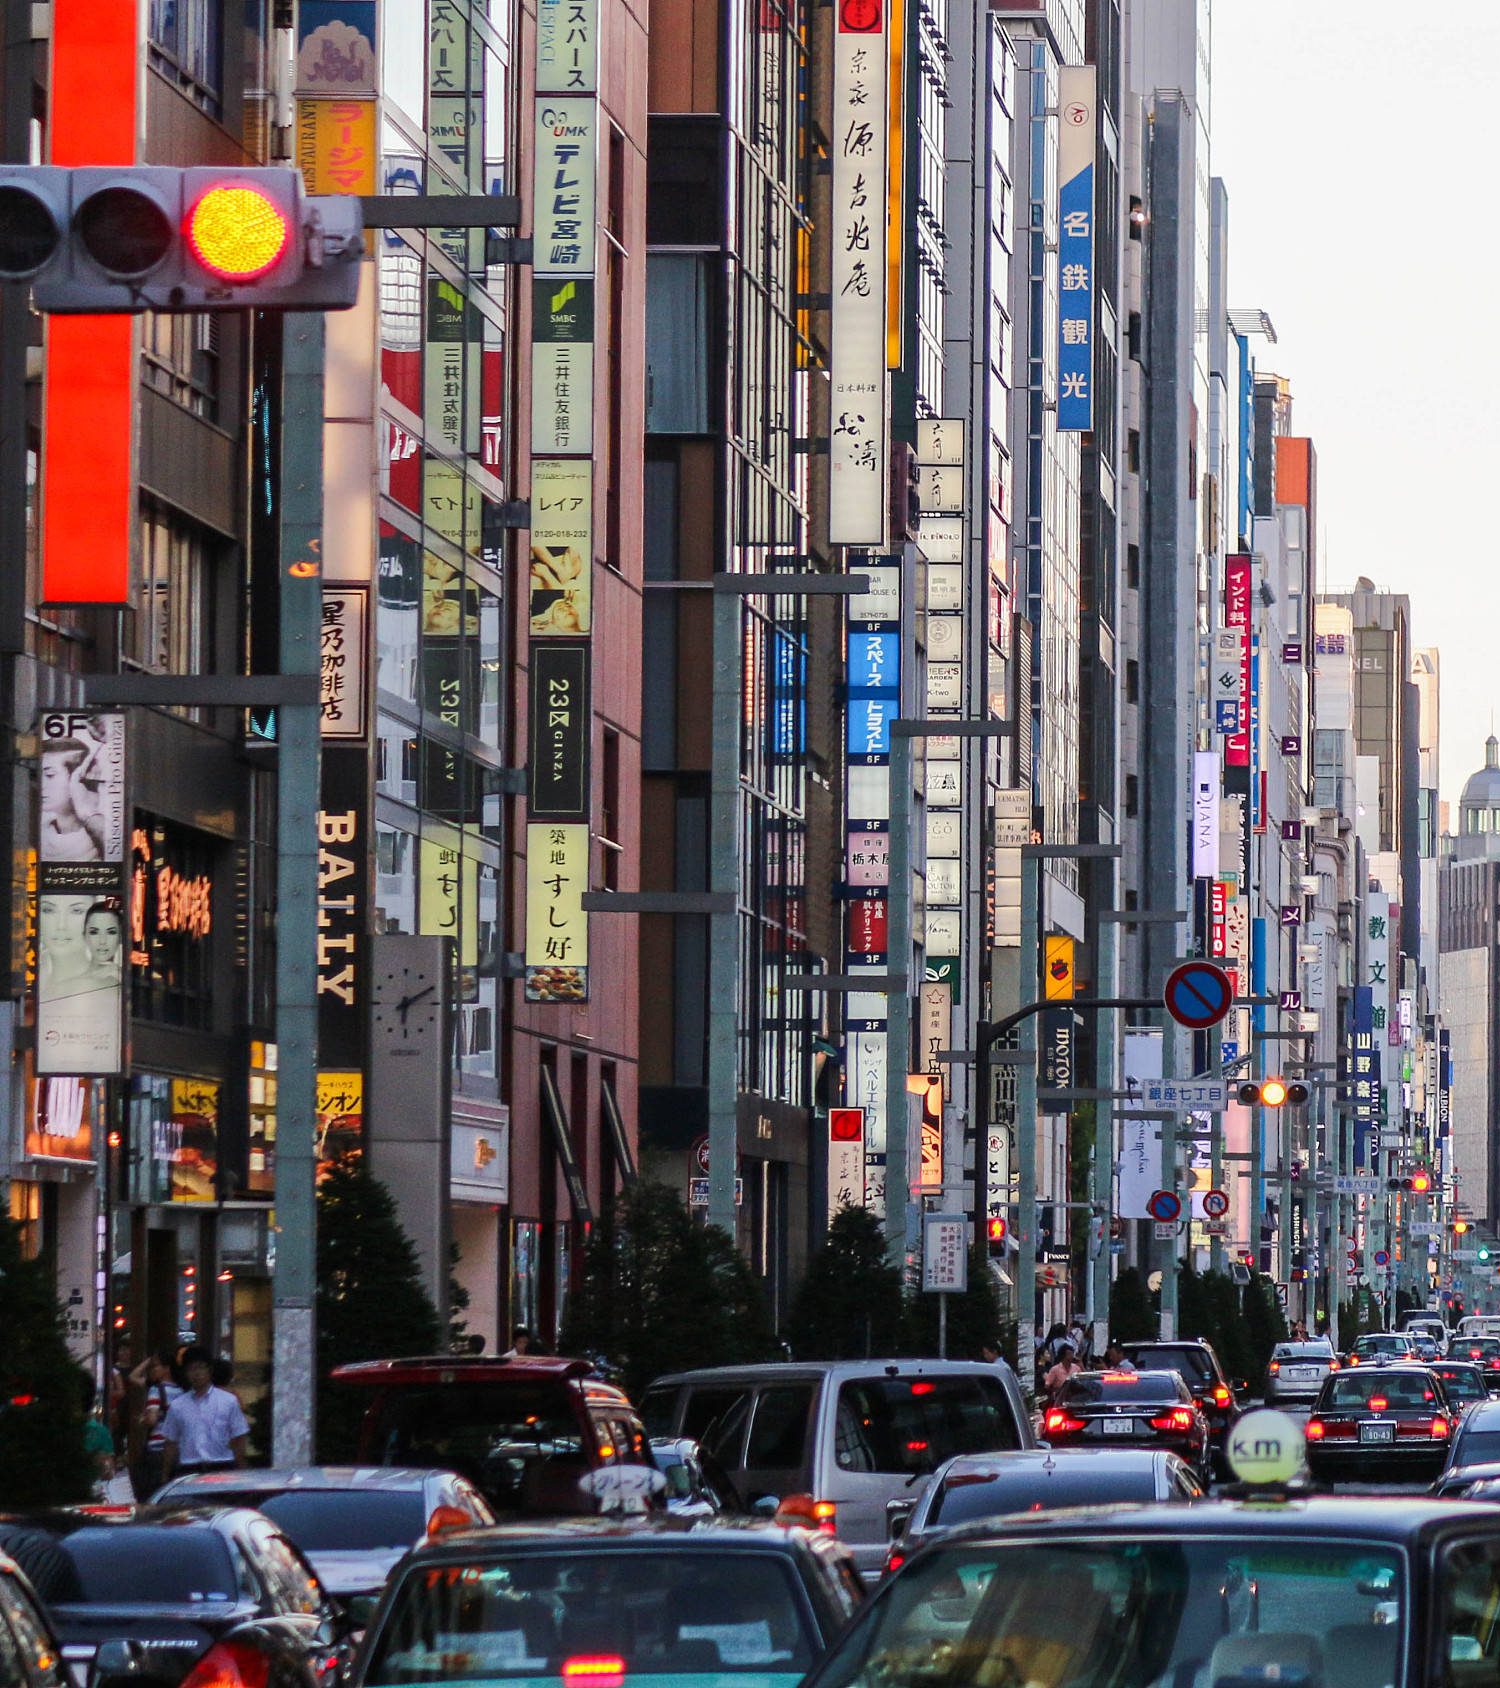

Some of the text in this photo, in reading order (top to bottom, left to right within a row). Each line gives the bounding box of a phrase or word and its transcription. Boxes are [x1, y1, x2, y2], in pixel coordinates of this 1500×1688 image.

[566, 0, 588, 88] スパース
[553, 125, 589, 137] UMK
[327, 102, 365, 196] ラージマ
[550, 144, 582, 265] テレビ宮崎
[1062, 212, 1089, 399] 名鉄観光
[549, 313, 577, 324] SMBC
[554, 347, 571, 448] 三井住友銀行
[836, 382, 878, 394] 日本料理
[539, 497, 584, 511] レイア
[867, 556, 881, 566] 9F
[867, 622, 881, 632] 8F
[865, 636, 884, 753] スペーストラスト
[44, 714, 89, 738] 6F
[105, 719, 124, 764] Ginza
[552, 730, 563, 782] GINZA
[866, 755, 881, 764] 6F
[105, 770, 122, 796] Pro
[866, 821, 881, 831] 5F
[1199, 788, 1215, 850] DIANA
[542, 827, 573, 962] 築地すし好
[866, 888, 880, 898] 4F
[315, 808, 357, 1006] BALLY
[866, 954, 880, 964] 3F
[866, 1021, 880, 1031] 2F
[1148, 1087, 1222, 1101] 銀座七丁目
[1440, 1088, 1449, 1122] ALBION
[1232, 1438, 1282, 1461] km
